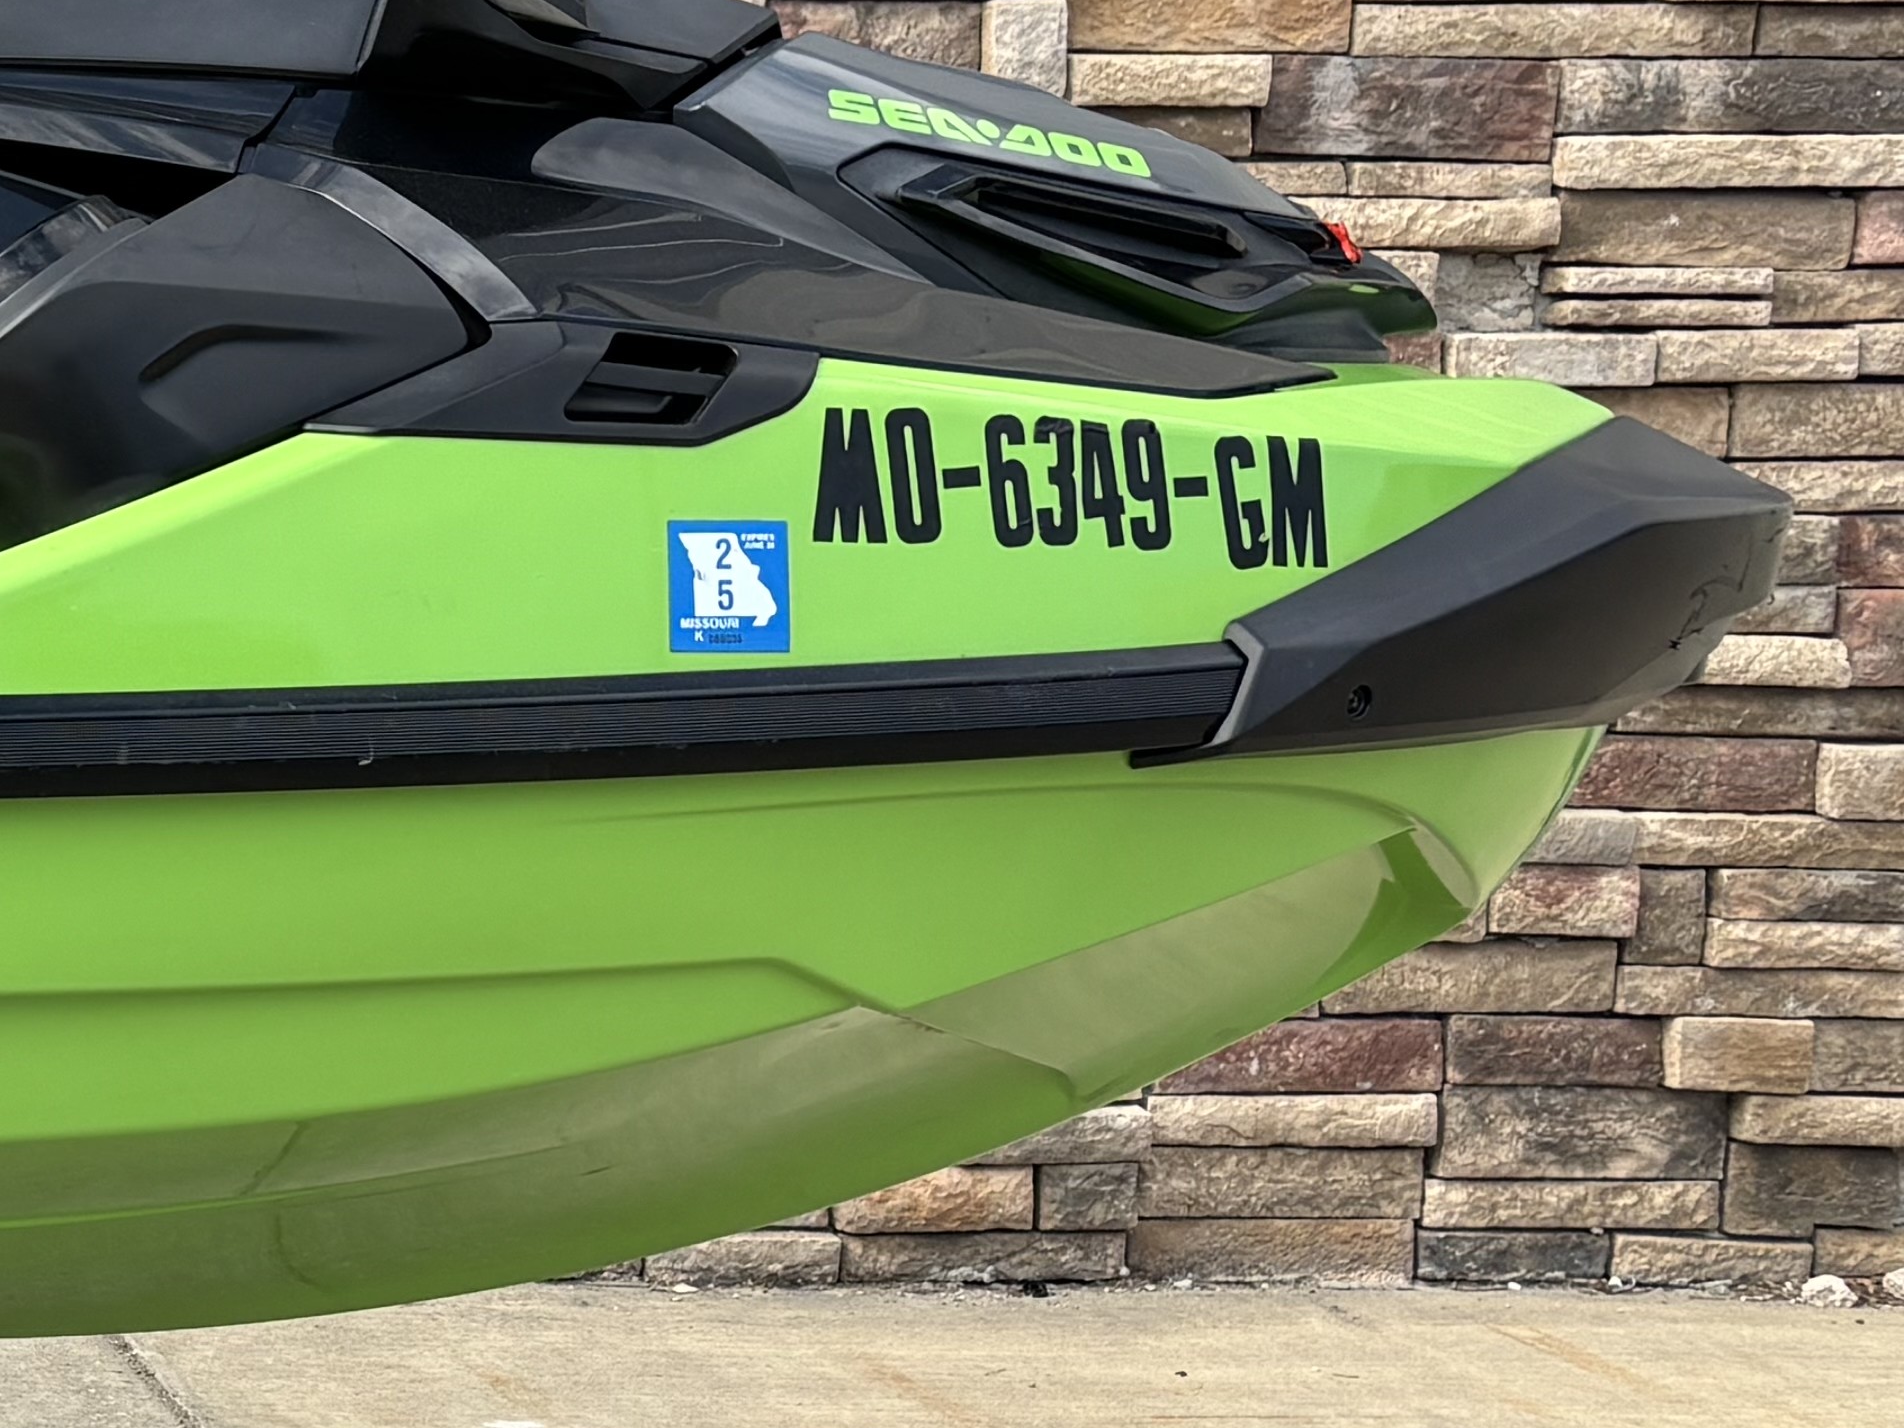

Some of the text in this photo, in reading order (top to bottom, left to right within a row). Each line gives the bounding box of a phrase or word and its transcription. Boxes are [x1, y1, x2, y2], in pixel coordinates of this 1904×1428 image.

[812, 406, 1329, 570] MO-6349-GM
[715, 538, 732, 569] 2
[718, 579, 734, 610] 5
[680, 617, 740, 629] MISSOURI
